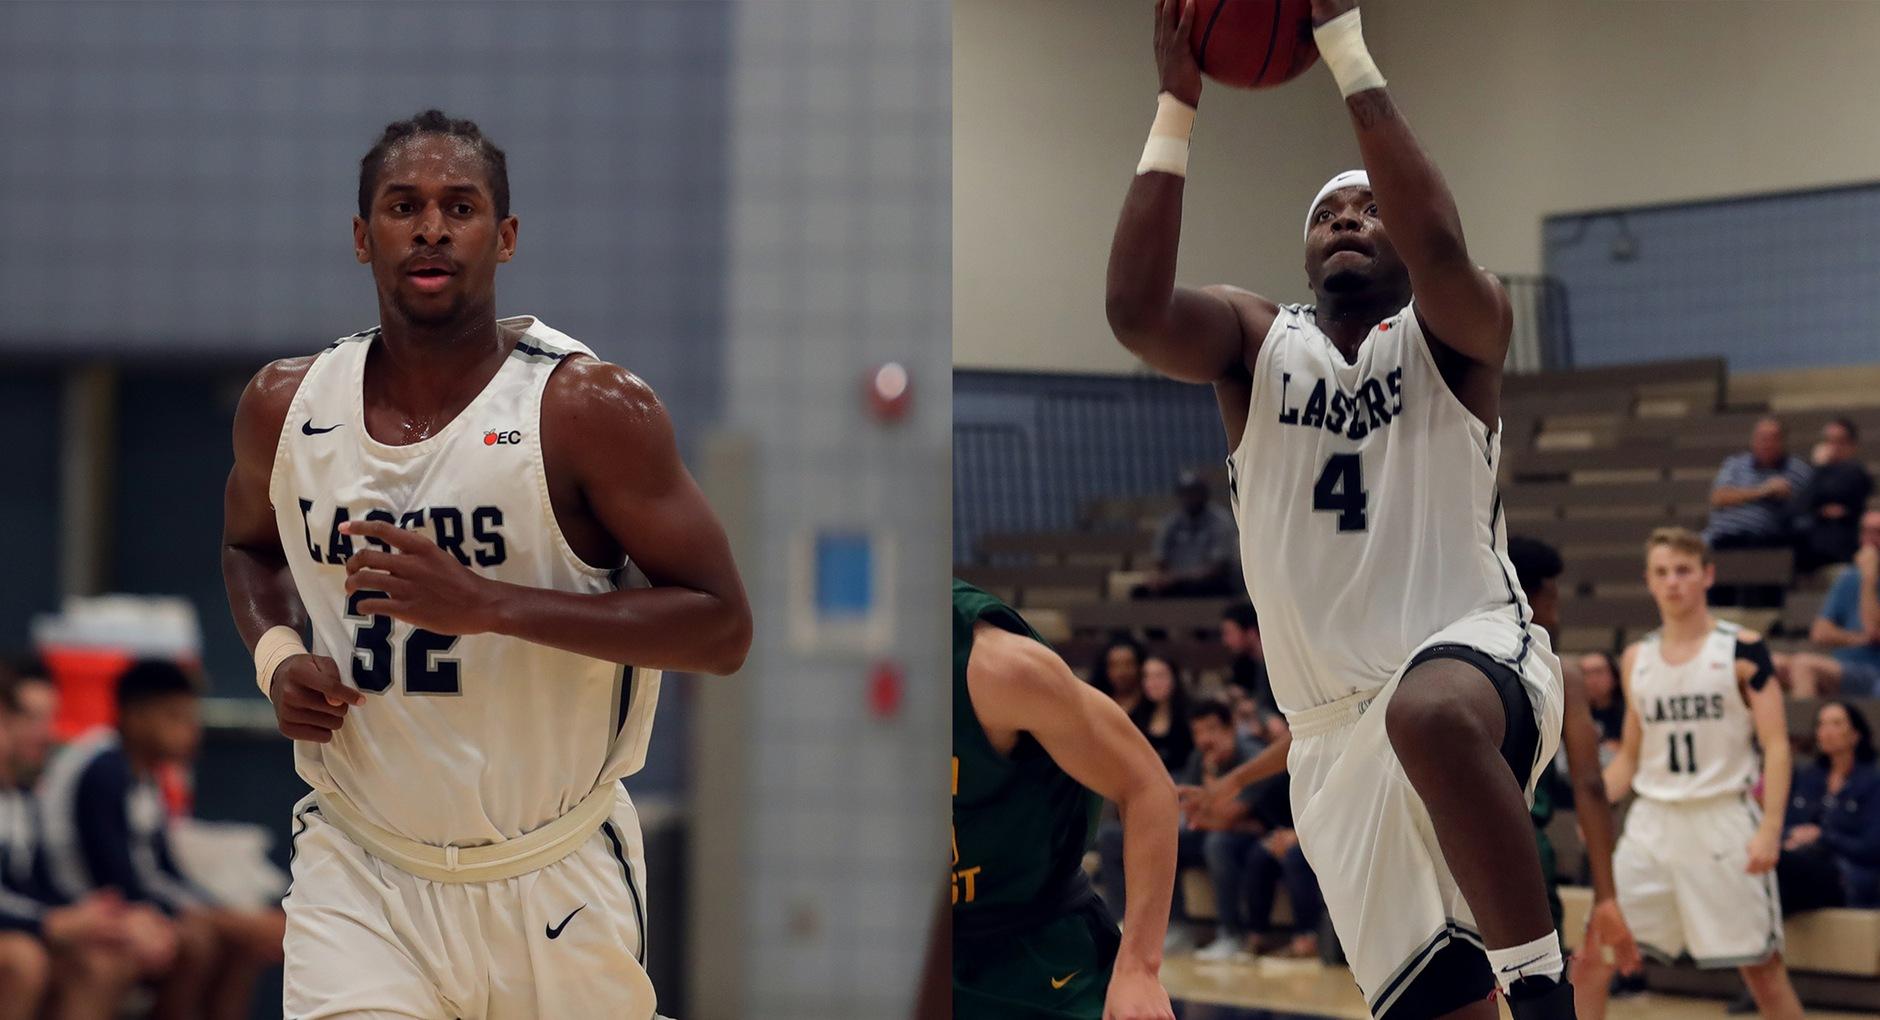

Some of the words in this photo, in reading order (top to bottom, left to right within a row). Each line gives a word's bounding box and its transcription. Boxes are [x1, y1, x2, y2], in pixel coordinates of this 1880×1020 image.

[1312, 451, 1369, 535] 4
[343, 590, 463, 696] 32
[1668, 732, 1697, 773] 11
